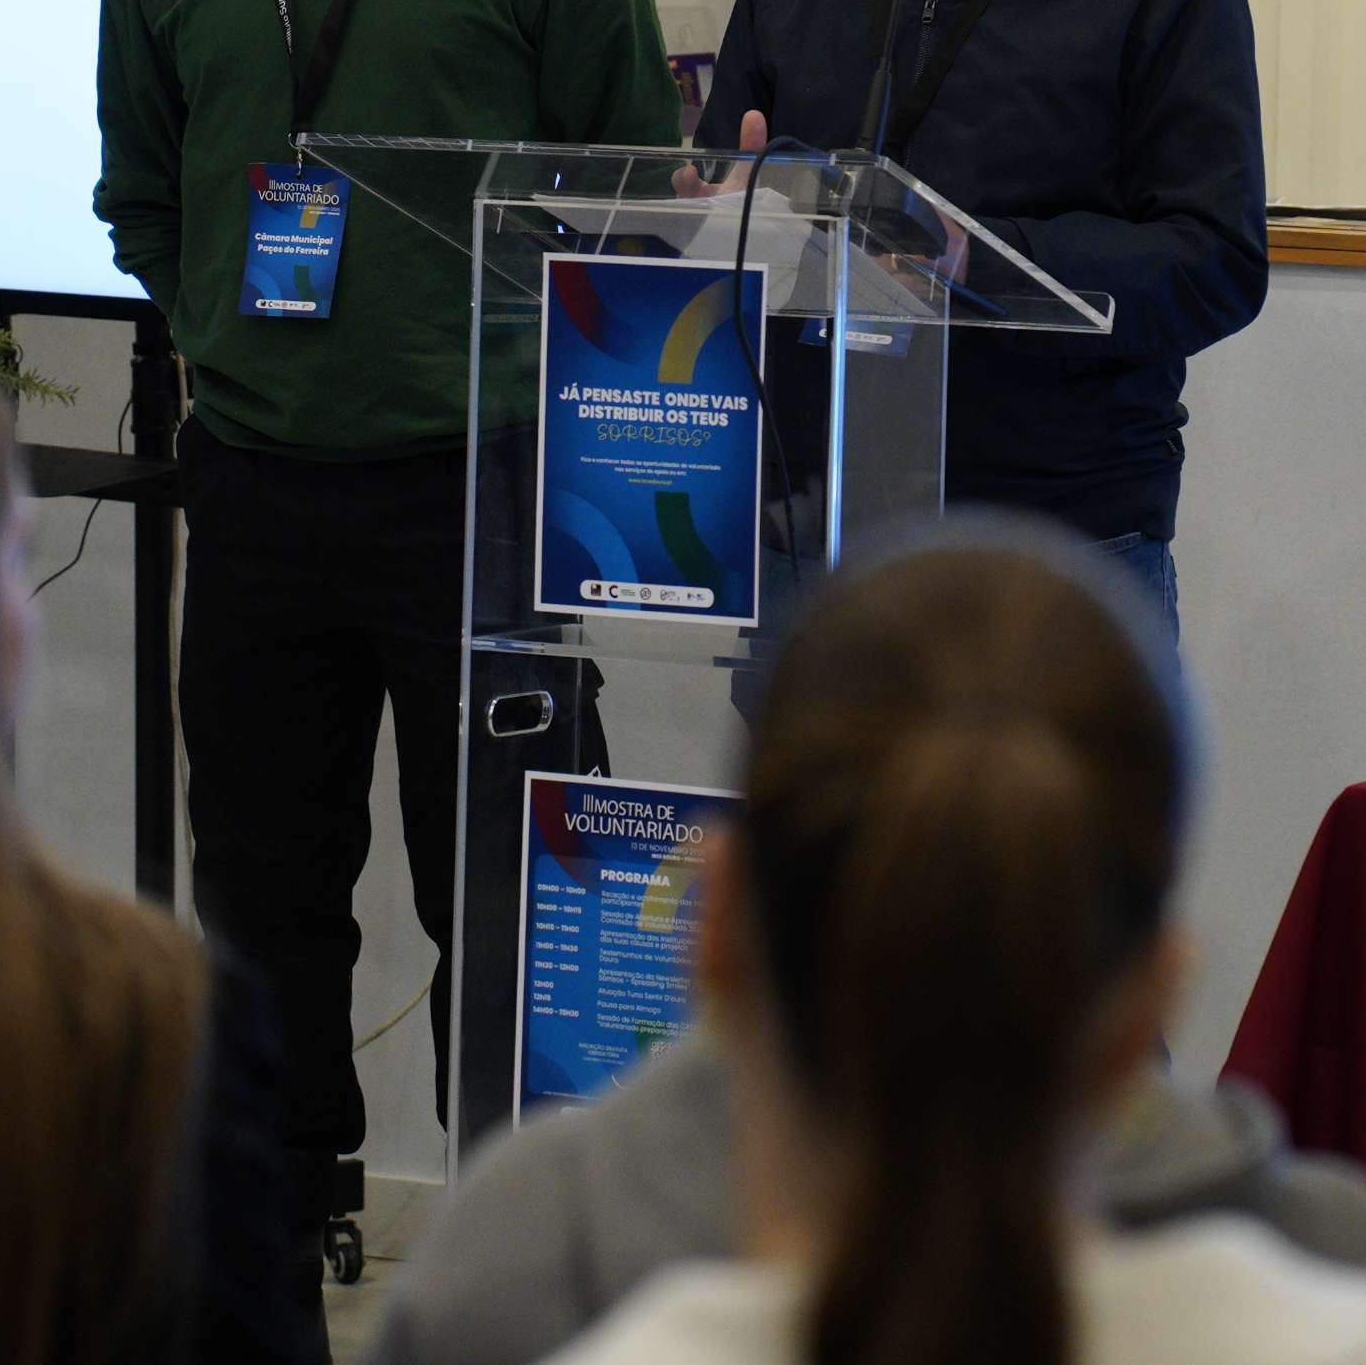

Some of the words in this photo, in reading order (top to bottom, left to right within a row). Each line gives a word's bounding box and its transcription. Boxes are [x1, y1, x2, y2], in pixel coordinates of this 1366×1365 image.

[312, 184, 324, 194] DE
[258, 190, 339, 205] VOLUNTARIADO
[254, 232, 290, 243] Câmara
[290, 235, 334, 247] Municipal
[257, 244, 284, 255] Paços
[559, 382, 580, 401] JÁ
[583, 388, 660, 405] PENSASTE
[664, 392, 708, 408] ONDE
[711, 395, 749, 411] VAIS
[578, 405, 664, 423] DISTRIBUIR
[666, 410, 687, 424] OS
[690, 412, 729, 427] TEUS
[657, 805, 675, 821] DE
[565, 812, 704, 844] VOLUNTARIADO
[600, 869, 671, 887] PROGRAMA
